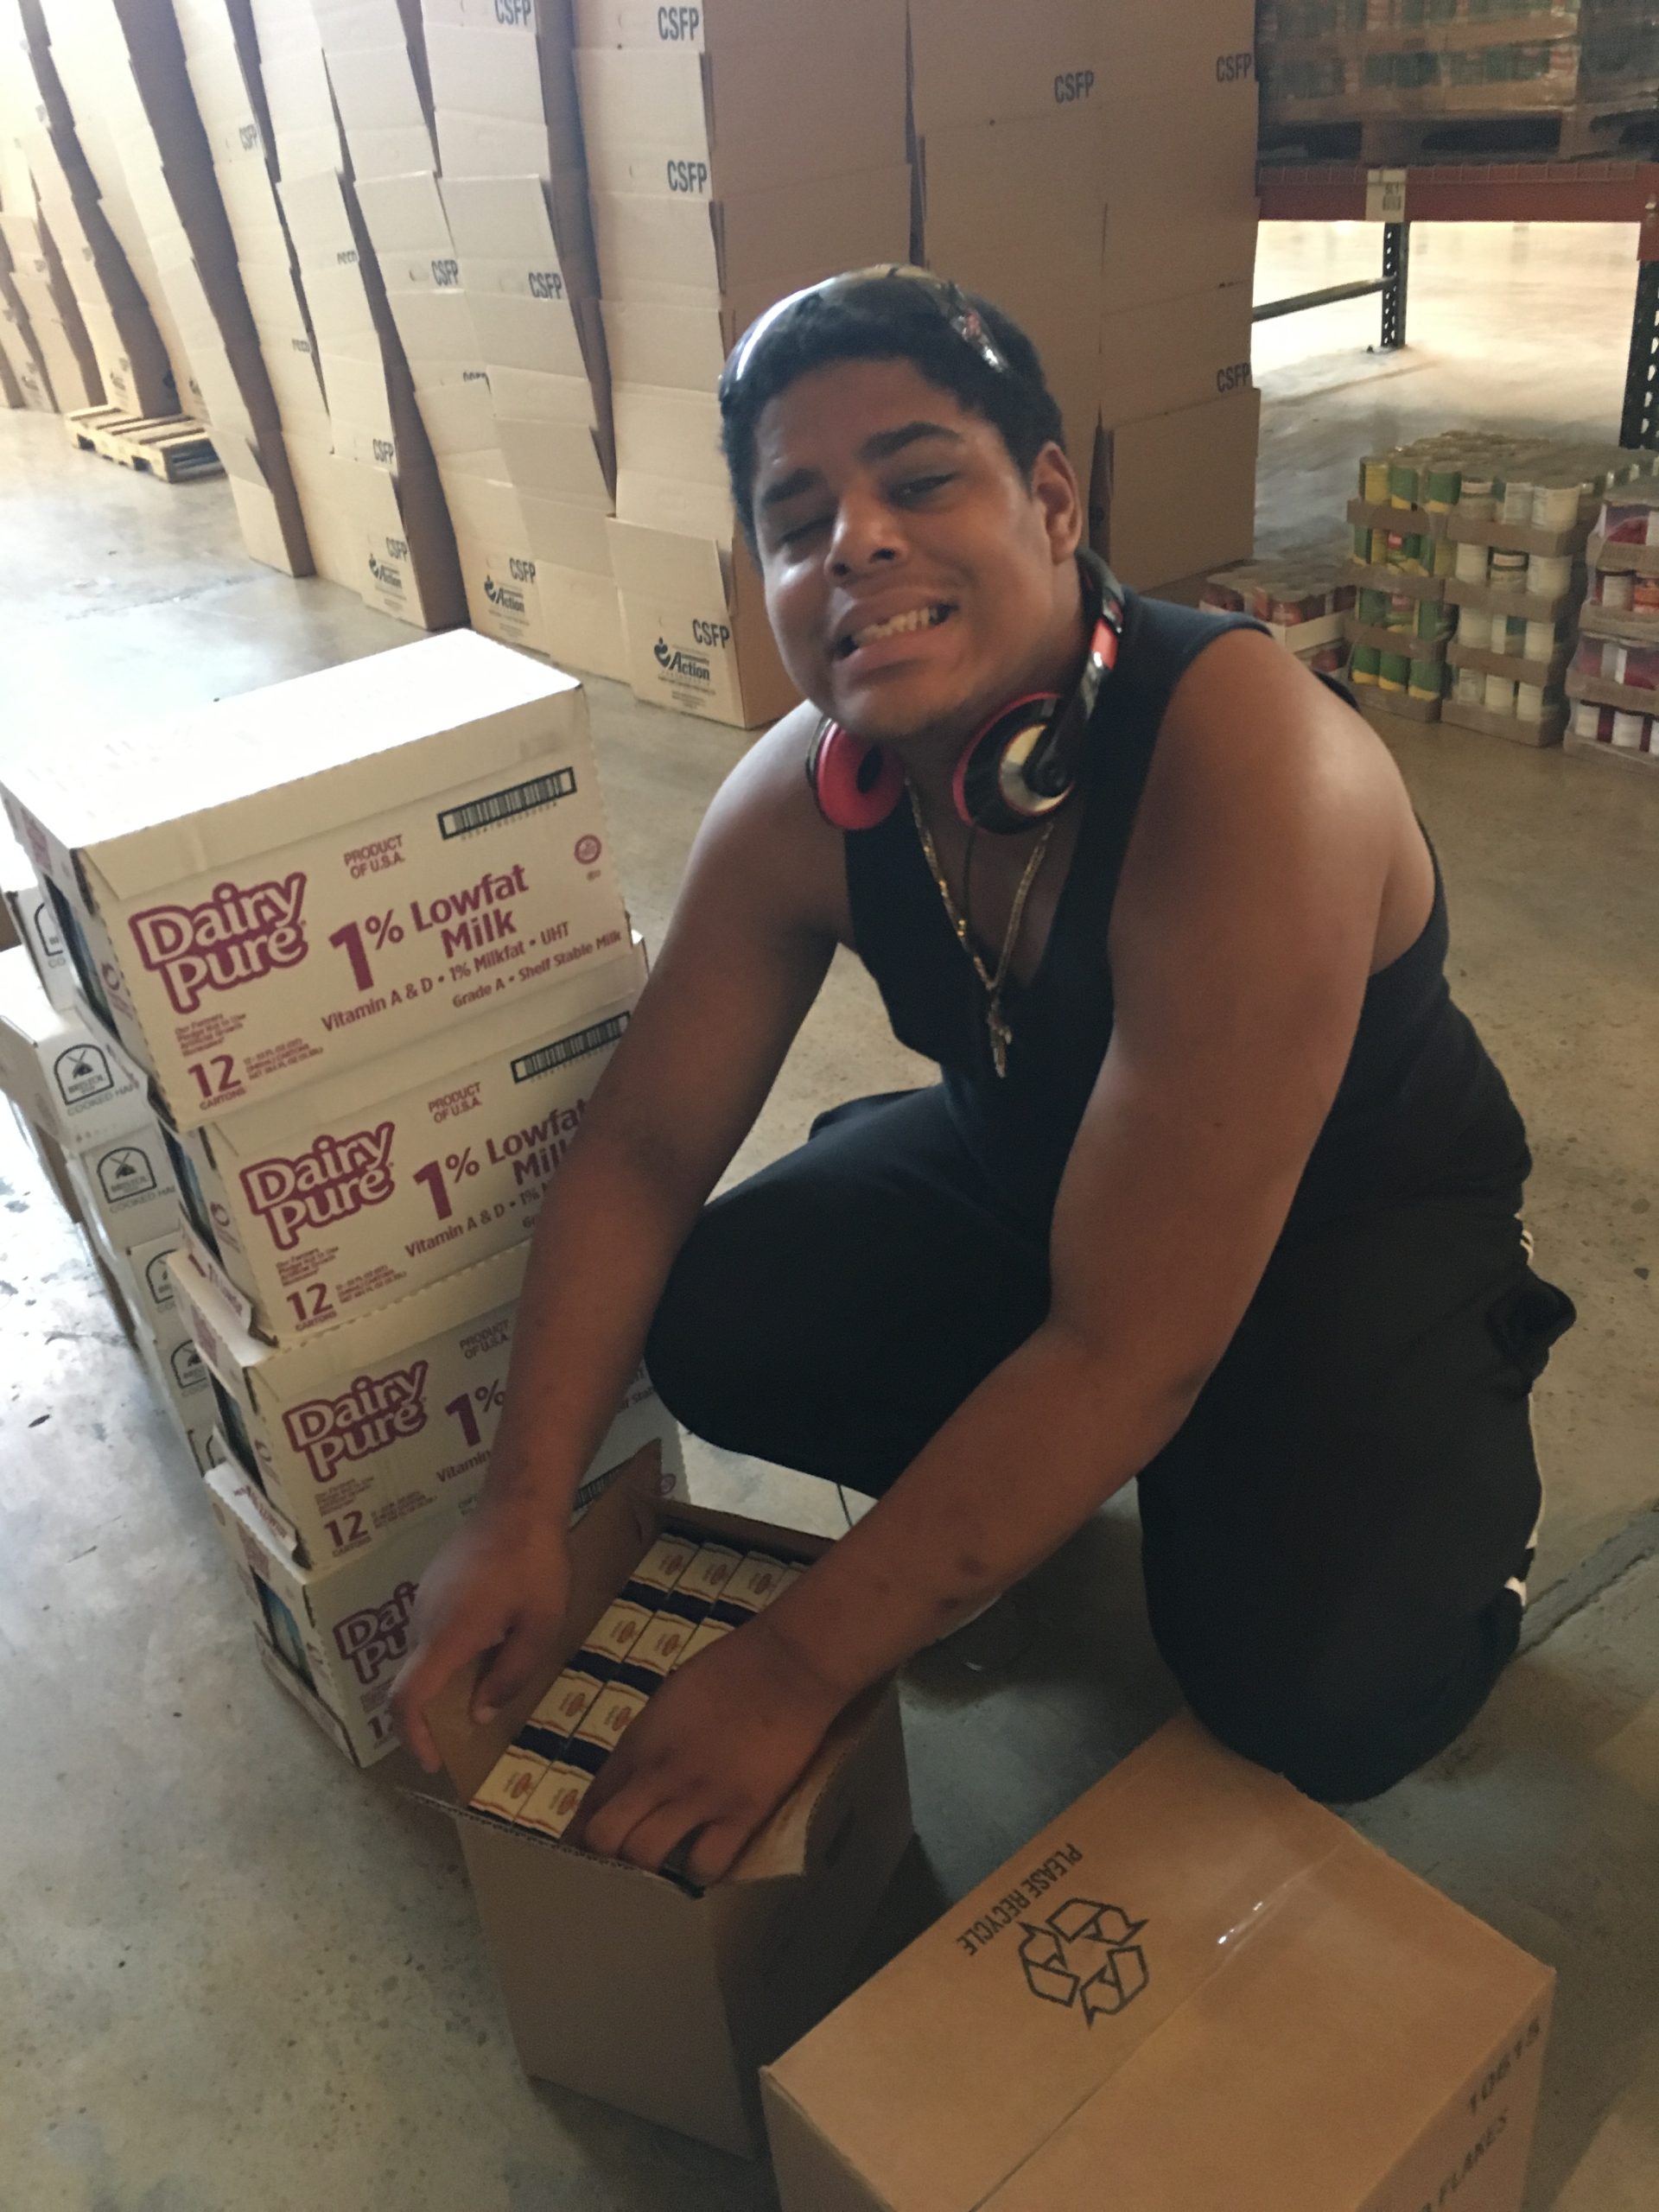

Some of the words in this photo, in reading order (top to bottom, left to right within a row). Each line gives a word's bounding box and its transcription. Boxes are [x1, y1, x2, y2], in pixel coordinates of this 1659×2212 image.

[495, 0, 531, 26] CSFP
[658, 6, 699, 41] CSFP
[1216, 53, 1253, 83] CSFP
[1053, 70, 1094, 105] CSFP
[667, 161, 708, 194] CSFP
[431, 259, 459, 286] CSFP
[529, 272, 563, 300] CSFP
[1217, 362, 1250, 393] CSFP
[372, 439, 394, 464] CSFP
[385, 537, 409, 562] CSFP
[509, 557, 537, 584] CSFP
[495, 588, 525, 613] Action
[692, 619, 730, 649] CSFP
[669, 651, 710, 681] Action
[344, 834, 403, 867] PRODUCT
[350, 863, 369, 880] OF
[129, 873, 307, 970] Dairy
[328, 909, 404, 992] 1%
[410, 864, 529, 932] Lowfat
[441, 908, 517, 959] Milk
[160, 920, 308, 1014] Pure
[321, 995, 387, 1032] Vitamin
[390, 989, 403, 1007] A
[405, 983, 418, 1001] &
[421, 977, 434, 994] D
[449, 961, 472, 982] 1%
[473, 940, 526, 975] Milkfat
[540, 921, 570, 946] UHT
[452, 986, 493, 1009] Grade
[495, 978, 505, 991] A
[518, 961, 551, 982] Shelf
[553, 944, 594, 968] Stable
[595, 930, 623, 950] Milk
[188, 1054, 242, 1098] 12
[200, 1087, 247, 1110] CARTONS
[428, 1082, 481, 1113] PRODUCT
[434, 1108, 449, 1123] OF
[239, 1122, 395, 1216] Dairy
[412, 1147, 480, 1221] 1%
[263, 1164, 396, 1251] Pure
[404, 1224, 464, 1258] Vitamin
[467, 1217, 478, 1232] A
[480, 1211, 493, 1225] &
[493, 1203, 505, 1218] D
[286, 1282, 334, 1321] 12
[460, 1319, 509, 1350] PRODUCT
[464, 1345, 480, 1359] OF
[282, 1360, 429, 1452] Dairy
[445, 1379, 505, 1448] 1%
[303, 1400, 429, 1483] Pure
[436, 1449, 492, 1483] Vitamin
[324, 1510, 369, 1547] 12
[1020, 1842, 1083, 1898] PLEASE
[957, 1889, 1031, 1955] RECYCLE
